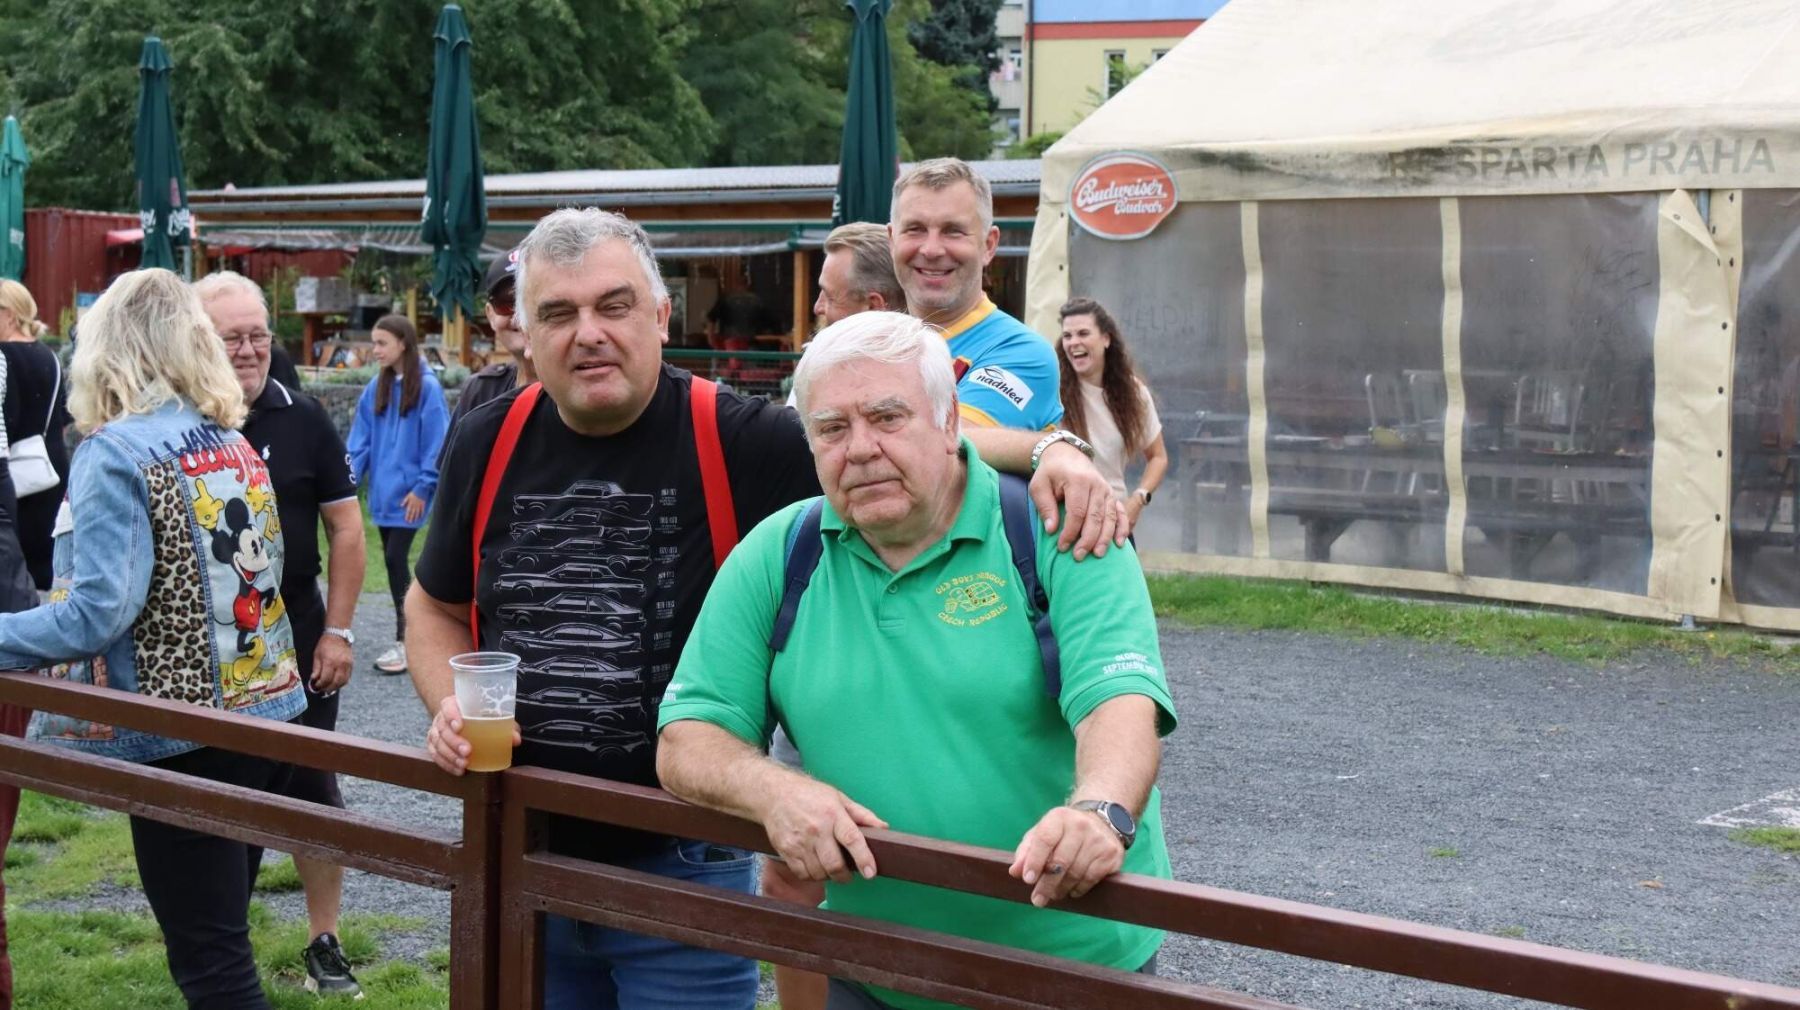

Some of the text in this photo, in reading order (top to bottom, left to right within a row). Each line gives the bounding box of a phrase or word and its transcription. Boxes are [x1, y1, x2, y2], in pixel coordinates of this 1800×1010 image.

[1457, 144, 1608, 180] SPARTA
[1623, 138, 1776, 176] PRAHA
[1076, 177, 1167, 208] Budweiser
[1114, 199, 1164, 215] Budvar
[976, 374, 1024, 404] nadhled
